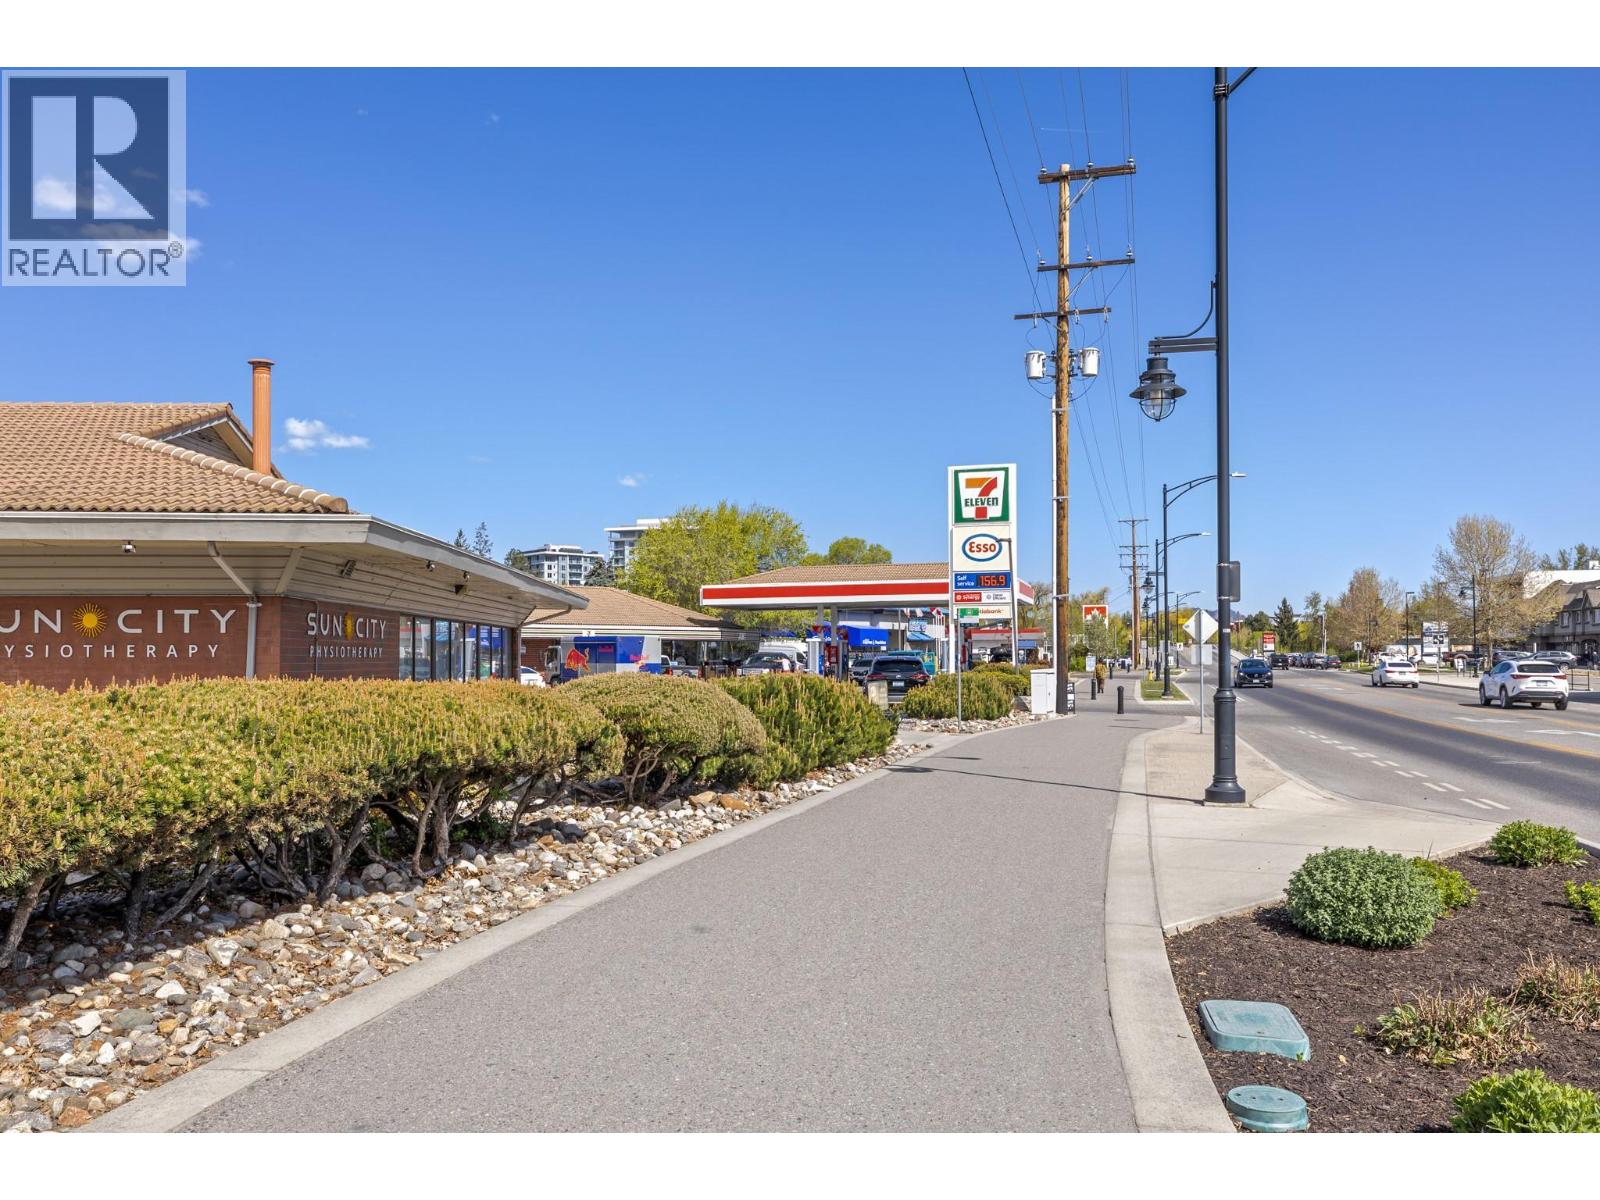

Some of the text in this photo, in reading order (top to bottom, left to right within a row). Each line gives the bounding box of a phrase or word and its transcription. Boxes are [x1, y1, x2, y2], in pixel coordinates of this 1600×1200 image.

[964, 497, 999, 508] ELEVEN
[980, 575, 1006, 587] 156.9
[117, 609, 237, 634] CITY
[307, 612, 387, 640] SUN CITY
[4, 644, 219, 659] YSIOTHERAPY
[309, 645, 384, 659] PHYSIOTHERAPY
